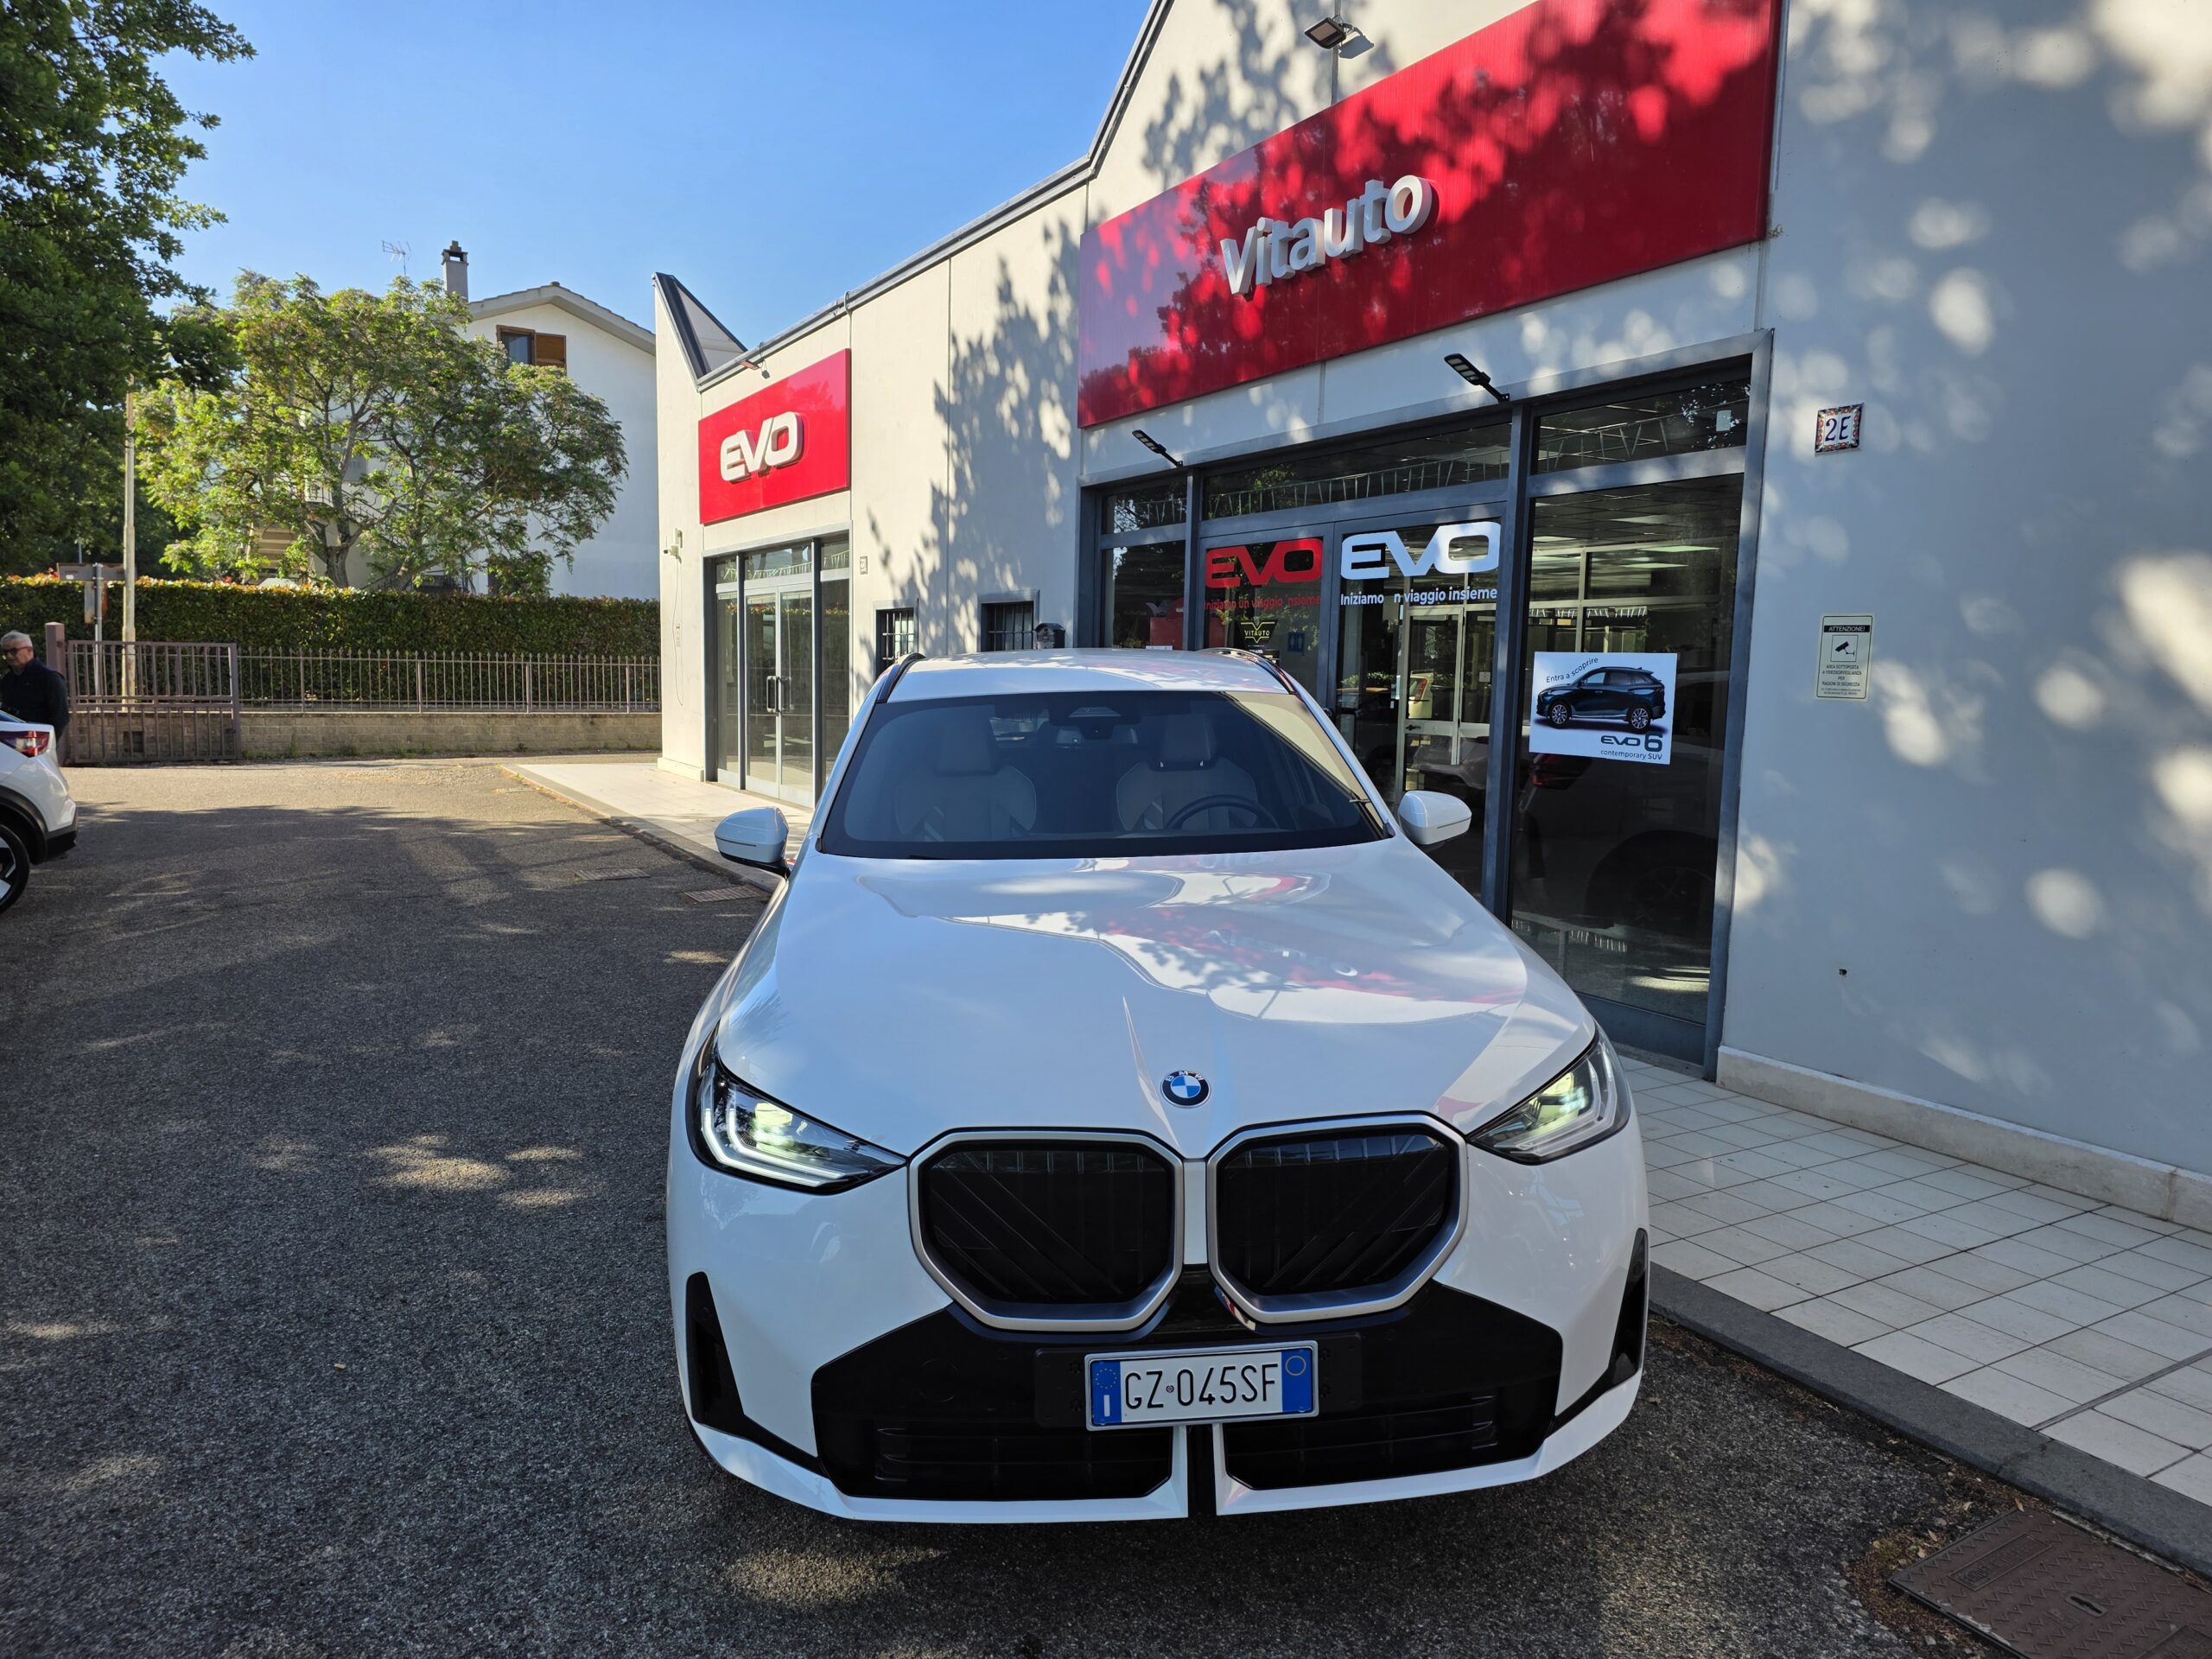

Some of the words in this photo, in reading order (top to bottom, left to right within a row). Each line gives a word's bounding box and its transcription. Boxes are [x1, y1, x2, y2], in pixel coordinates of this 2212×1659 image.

[1220, 175, 1432, 295] Vitauto
[1825, 416, 1851, 442] 2E
[721, 411, 804, 482] EVO
[1205, 537, 1323, 588] EVO
[1341, 521, 1501, 580] EVO
[1341, 591, 1384, 605] Iniziamo
[1404, 588, 1446, 605] viaggio
[1449, 586, 1497, 601] insieme
[1547, 674, 1564, 683] Entra
[1571, 658, 1599, 677] scoprire
[1600, 735, 1641, 747] EVO
[1644, 731, 1663, 752] 6
[1600, 750, 1647, 760] contemporary
